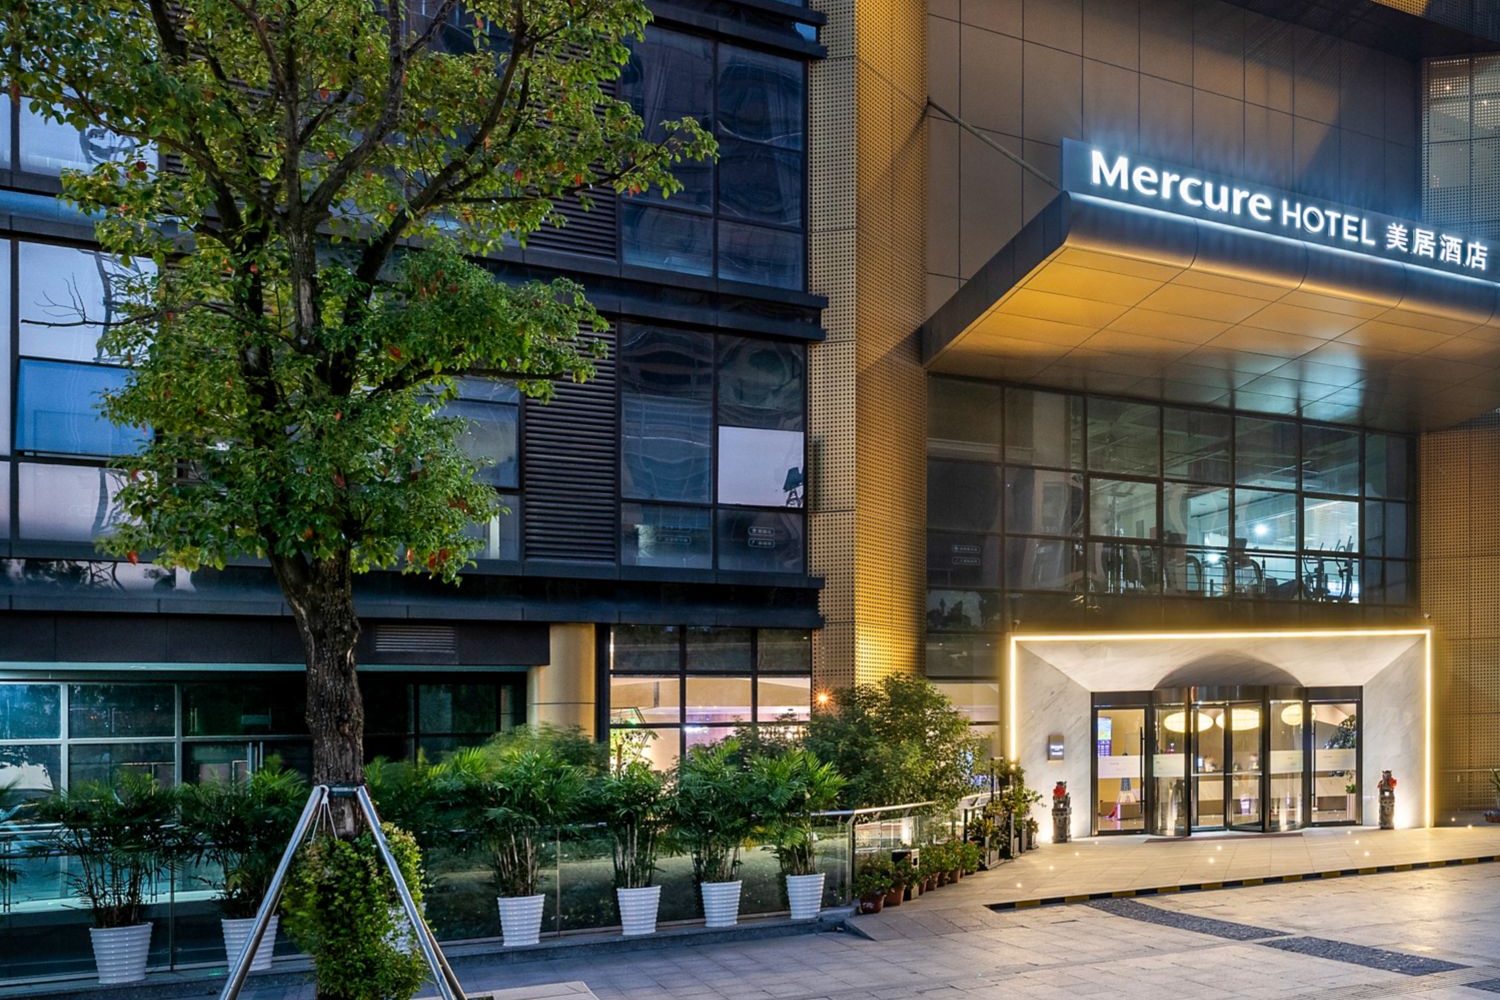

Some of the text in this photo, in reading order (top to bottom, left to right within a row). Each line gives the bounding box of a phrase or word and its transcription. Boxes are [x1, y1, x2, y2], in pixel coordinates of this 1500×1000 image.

[1091, 150, 1273, 222] Mercure
[1282, 199, 1376, 246] HOTEL
[1386, 222, 1488, 271] 美居酒店
